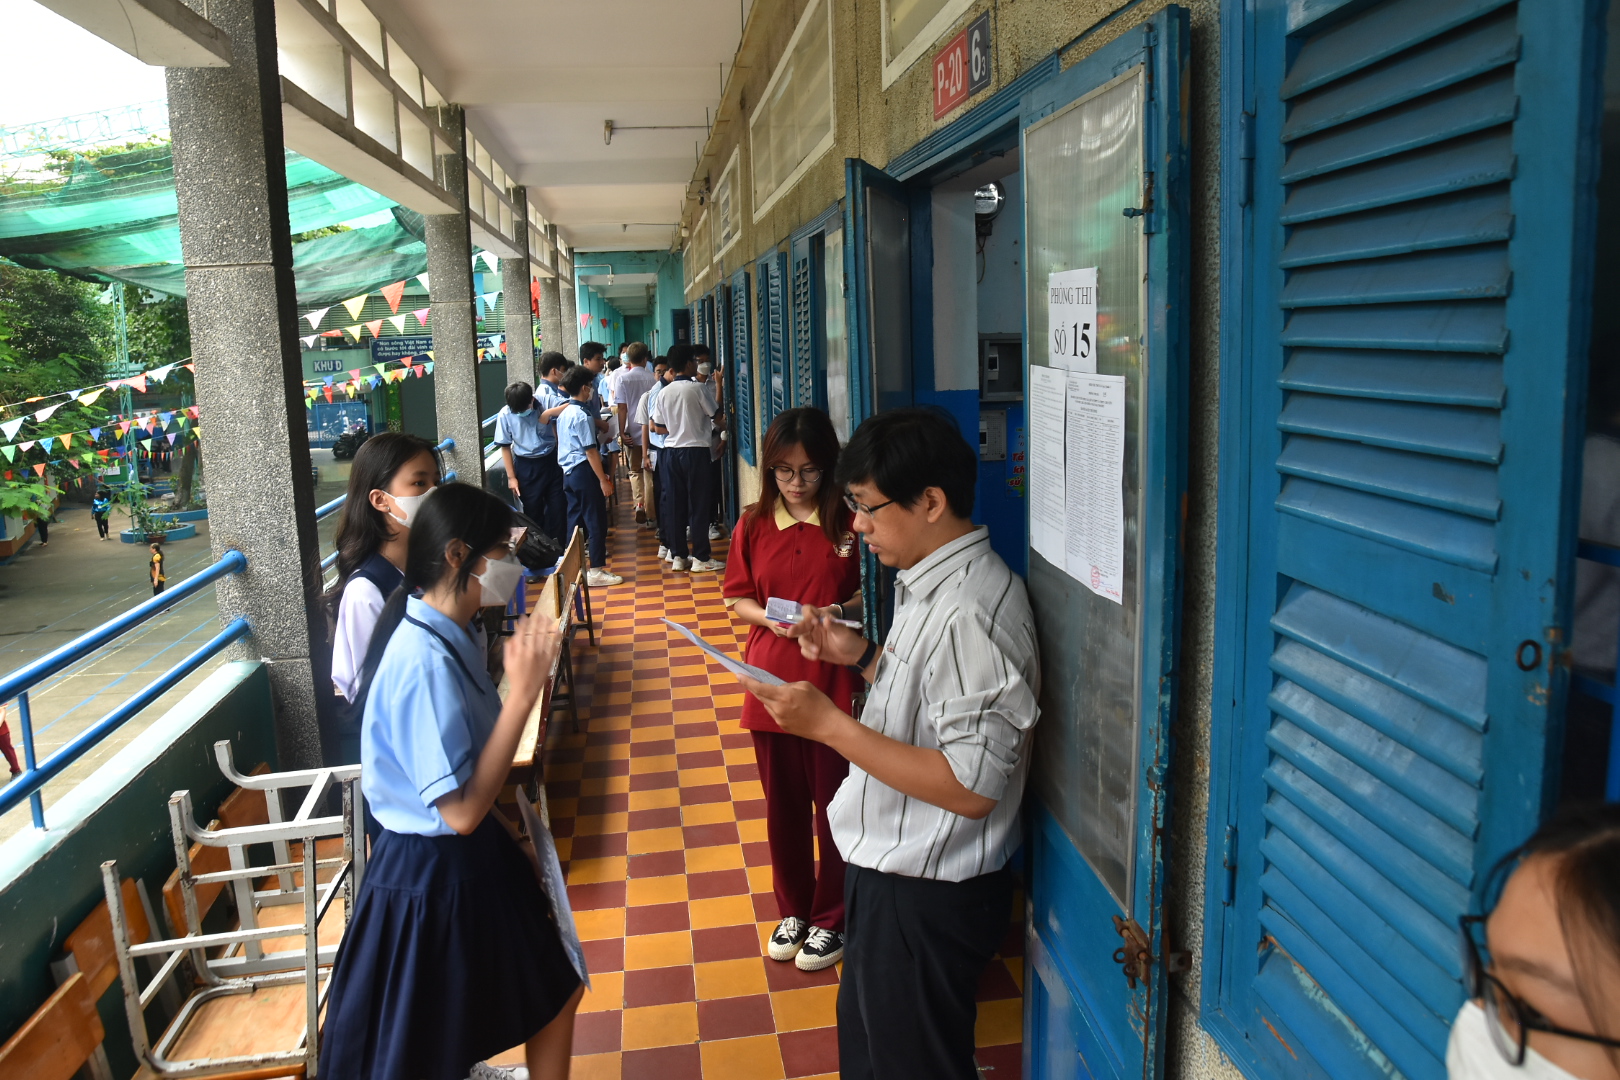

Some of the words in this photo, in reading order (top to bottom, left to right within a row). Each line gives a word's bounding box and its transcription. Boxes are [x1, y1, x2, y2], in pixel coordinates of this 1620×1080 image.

[972, 30, 980, 81] 6
[1050, 282, 1074, 304] PHÒNG
[1075, 286, 1092, 304] THI
[1054, 322, 1066, 356] SỐ
[1072, 322, 1090, 358] 15
[314, 361, 333, 371] KHU
[335, 361, 342, 370] D
